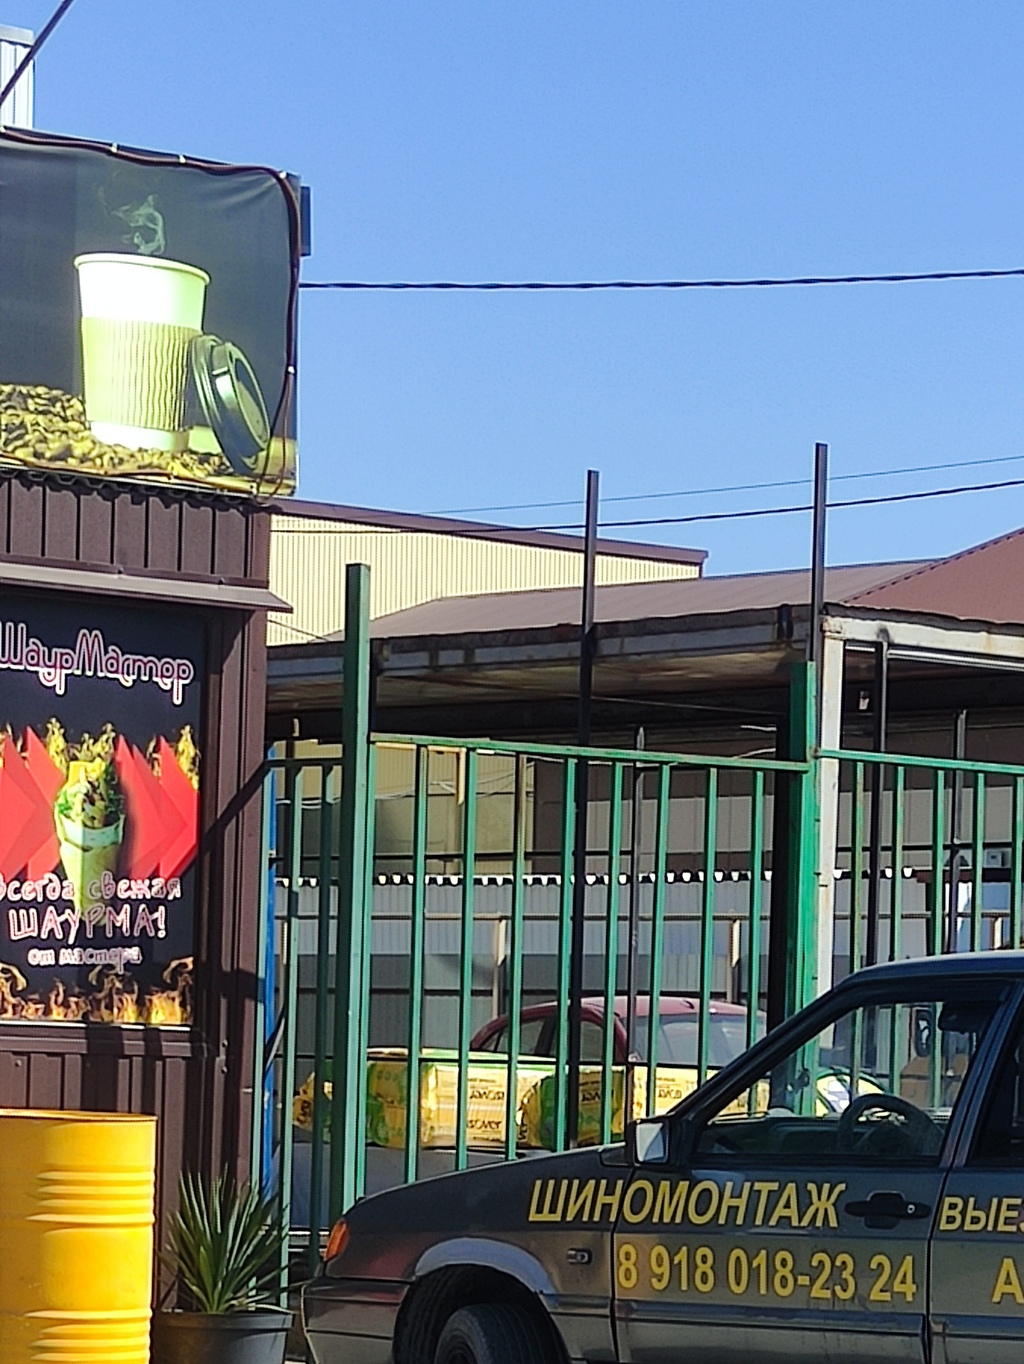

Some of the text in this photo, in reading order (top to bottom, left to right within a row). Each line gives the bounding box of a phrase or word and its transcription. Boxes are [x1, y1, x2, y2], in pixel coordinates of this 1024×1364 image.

[88, 871, 182, 900] свежая
[8, 903, 167, 945] ШАУРМА!
[28, 948, 56, 966] от
[528, 1178, 847, 1228] ШИНОМОНТАЖ
[618, 1244, 917, 1301] 8 918 018-23 24
